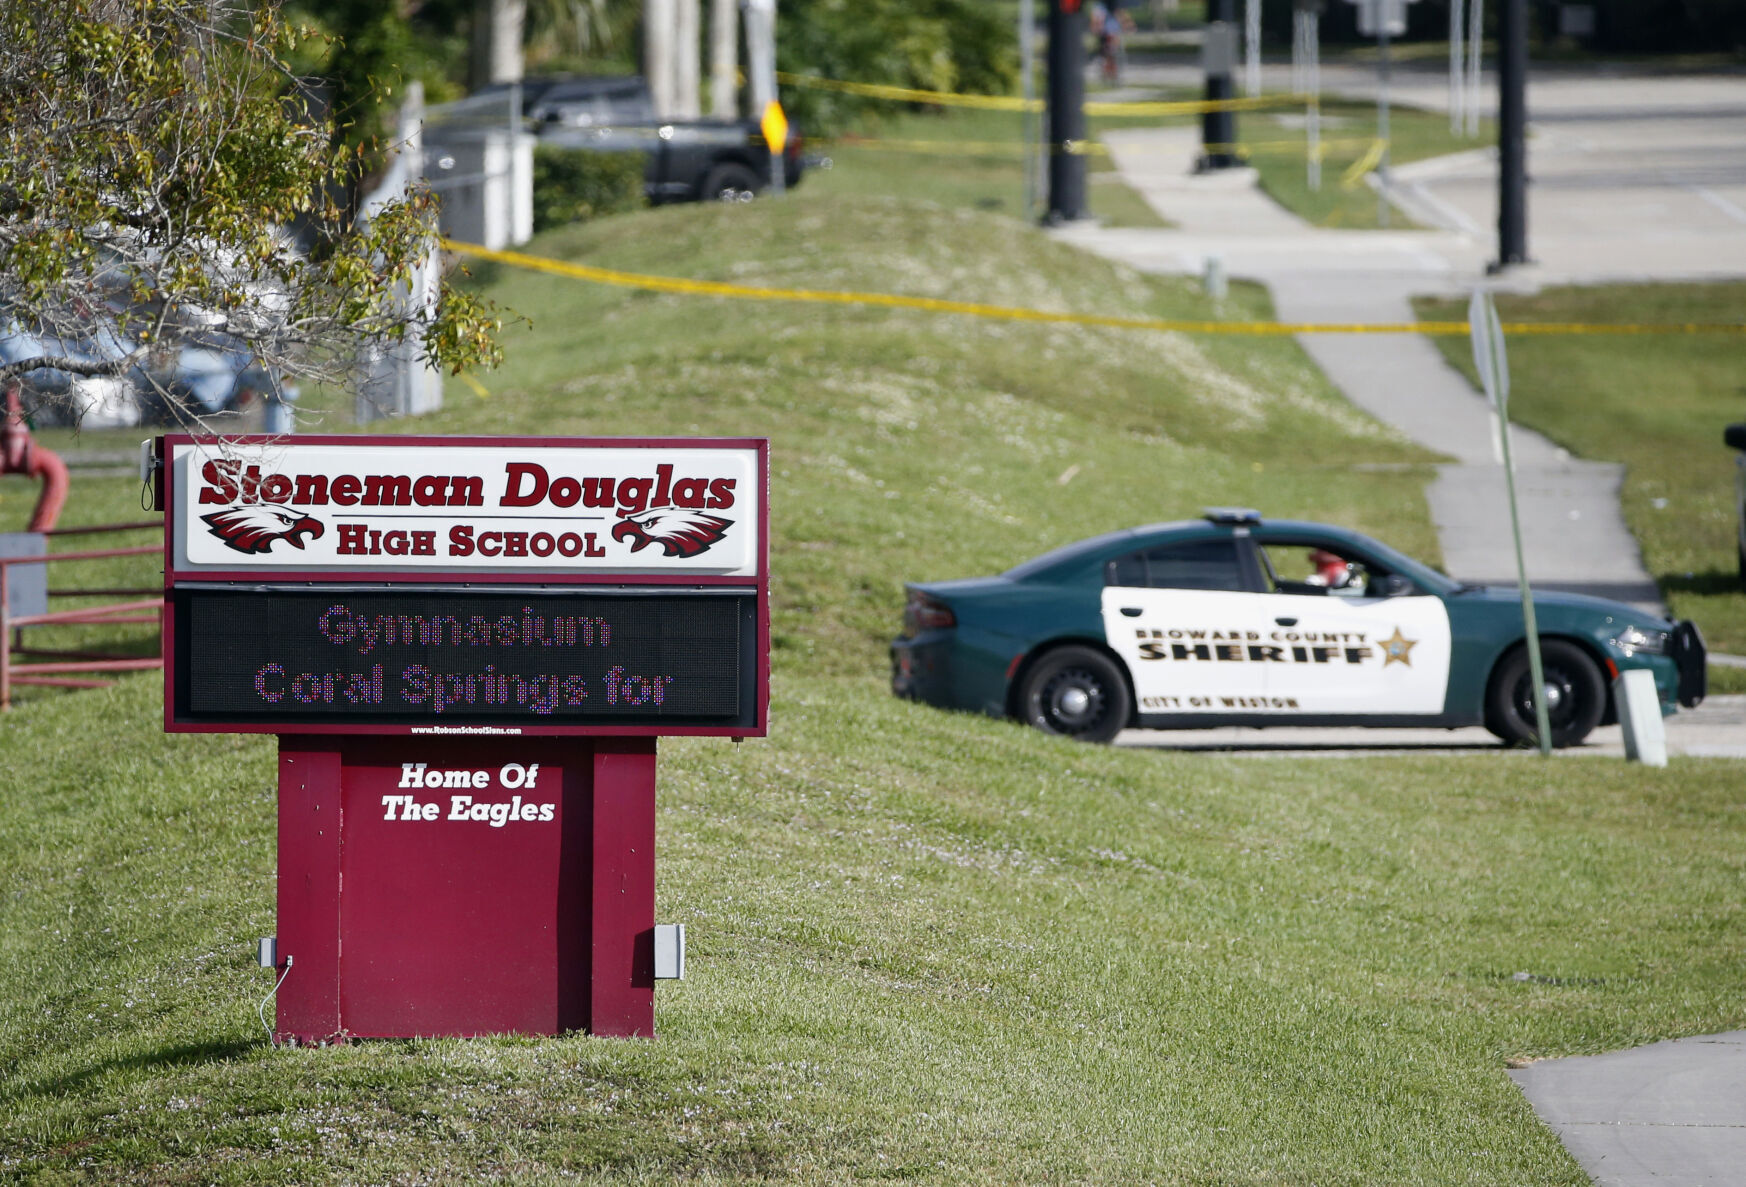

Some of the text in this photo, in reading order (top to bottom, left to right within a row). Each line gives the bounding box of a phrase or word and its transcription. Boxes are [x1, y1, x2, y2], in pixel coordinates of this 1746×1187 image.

[198, 459, 736, 518] Stoneman Douglas
[318, 604, 612, 655] Gymnasium
[1135, 629, 1367, 644] BROWARD COUNTY
[1138, 643, 1374, 664] SHERIFF
[254, 663, 674, 715] Coral Springs for
[1141, 696, 1300, 710] CITY OF WESTON
[398, 763, 539, 789] Home Of
[382, 795, 556, 828] The Eagles
